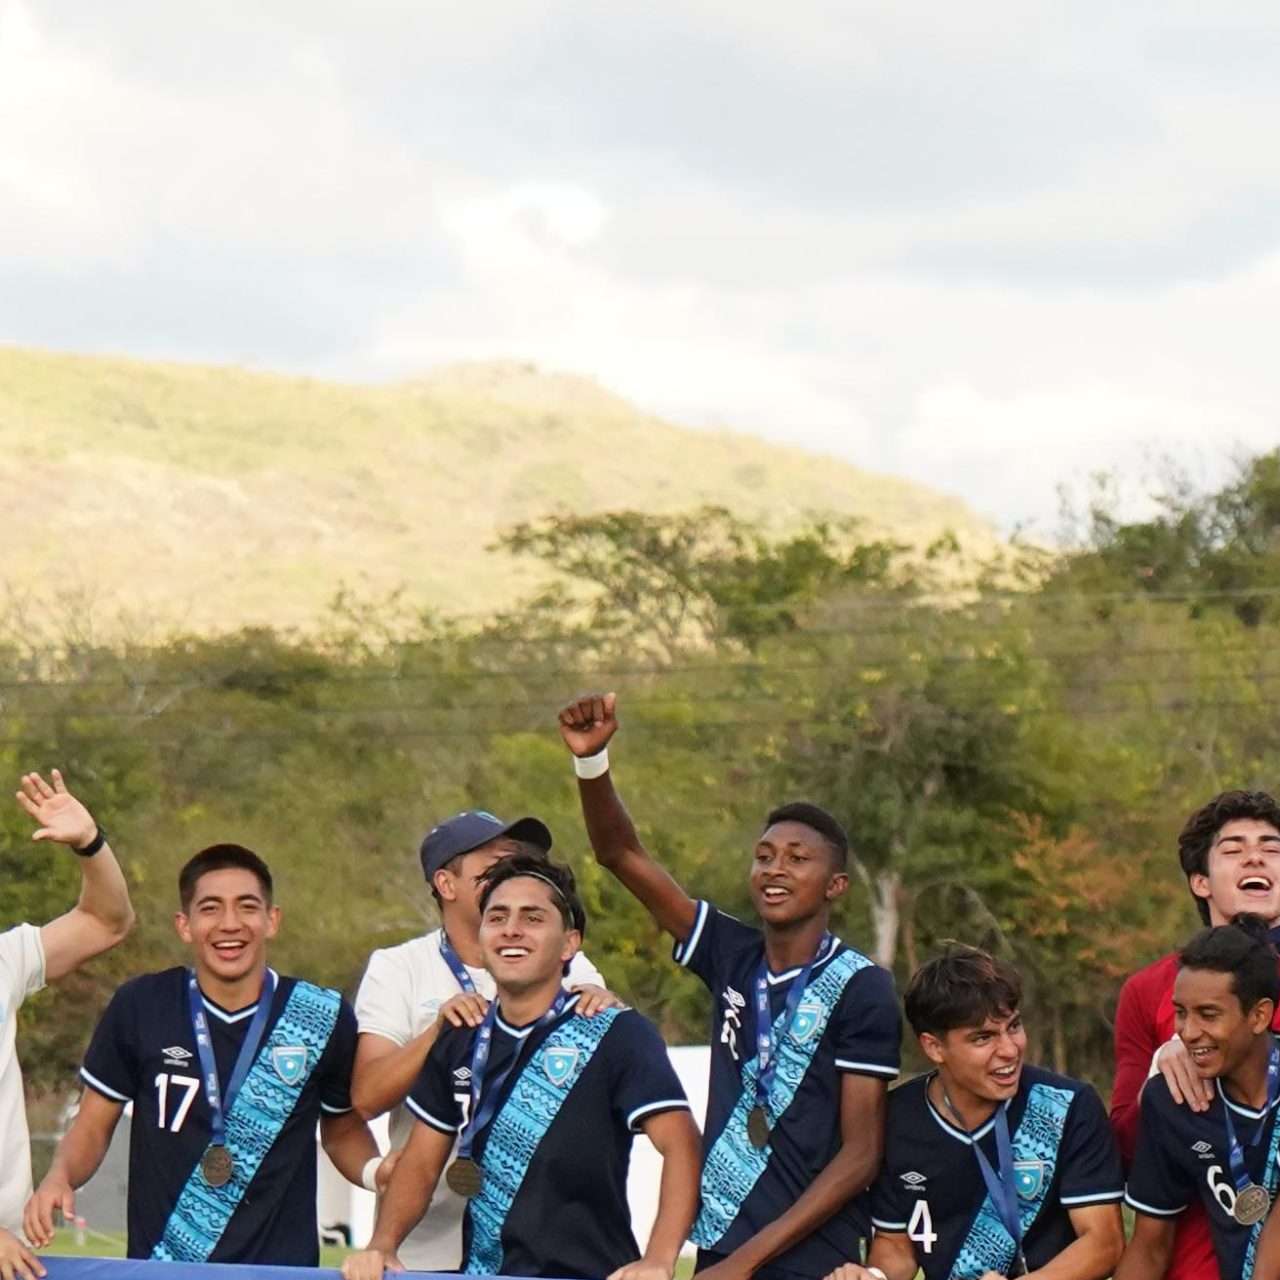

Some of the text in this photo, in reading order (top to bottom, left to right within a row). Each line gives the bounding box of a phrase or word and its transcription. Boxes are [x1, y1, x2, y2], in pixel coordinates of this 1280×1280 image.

[154, 1072, 200, 1133] 17
[1206, 1166, 1238, 1217] 6
[907, 1199, 938, 1254] 4
